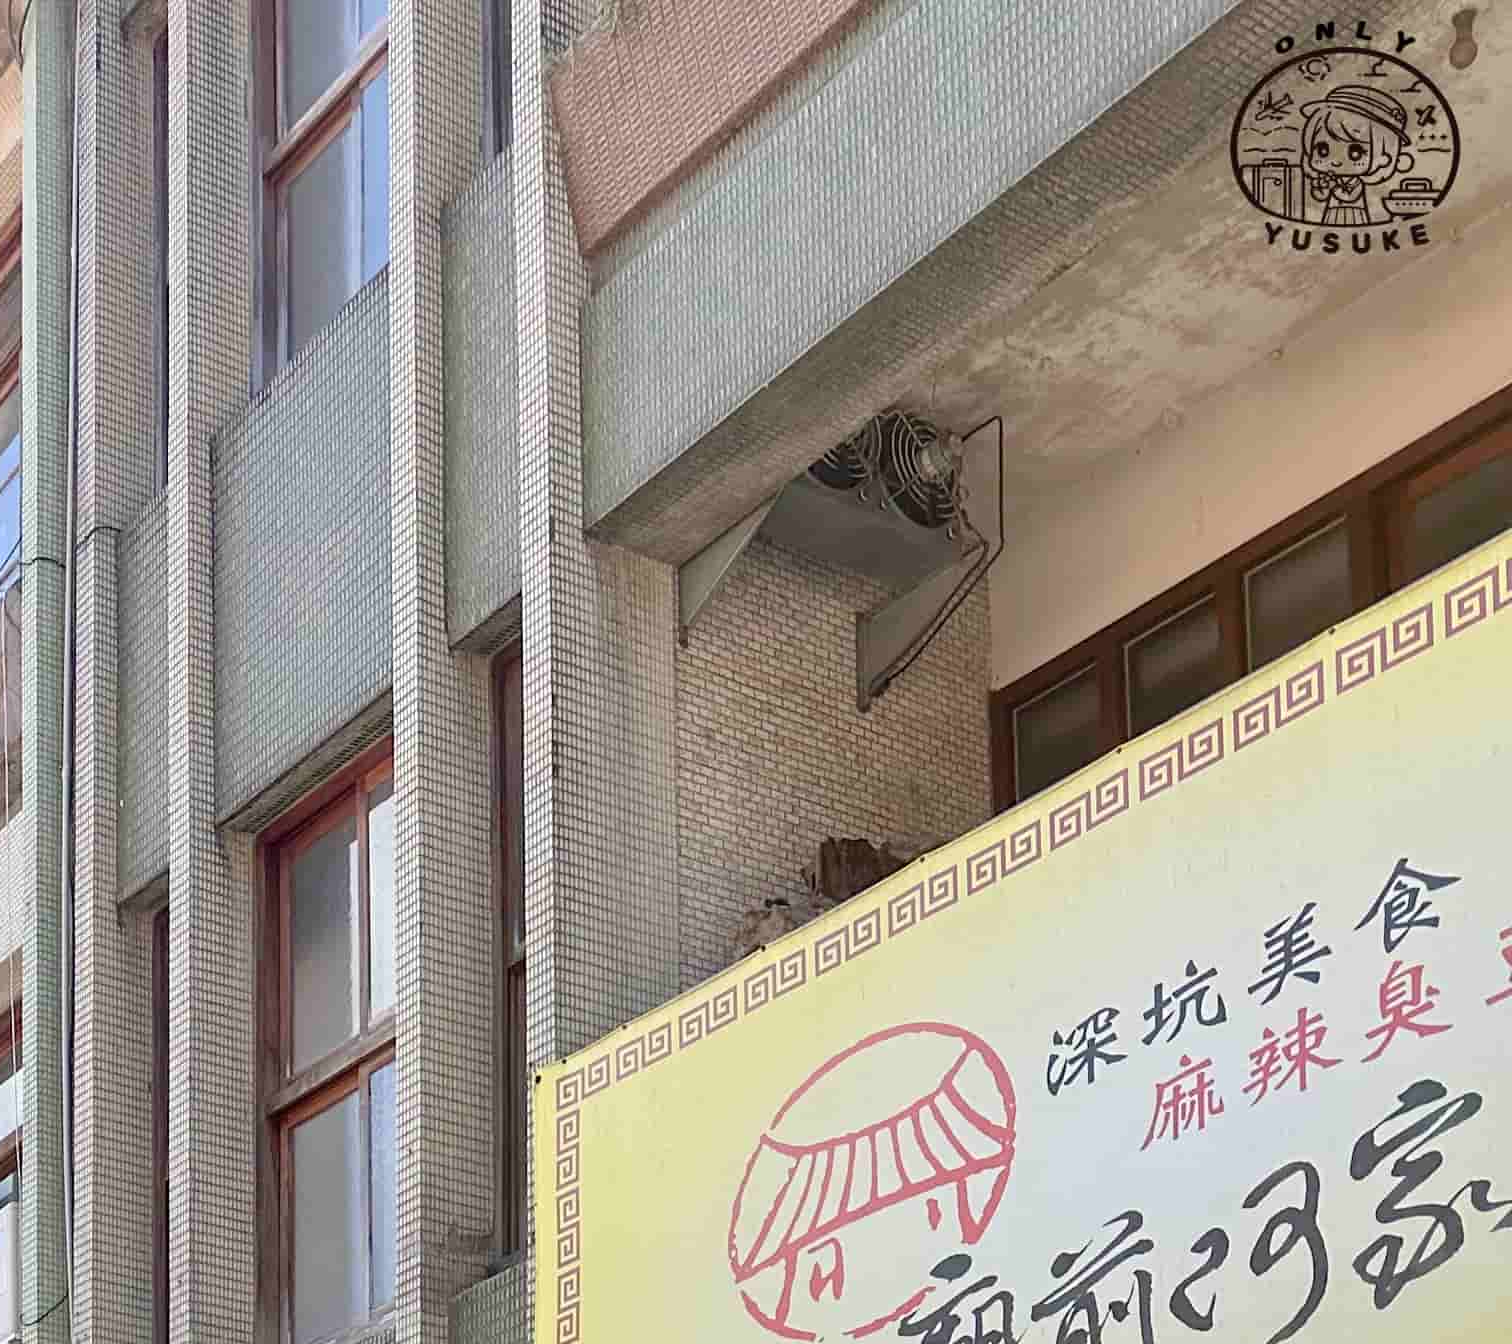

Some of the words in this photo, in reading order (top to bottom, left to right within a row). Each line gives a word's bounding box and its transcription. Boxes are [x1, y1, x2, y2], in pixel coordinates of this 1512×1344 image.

[1046, 857, 1462, 1096] 深坑美食
[1140, 927, 1512, 1151] 麻辣臭
